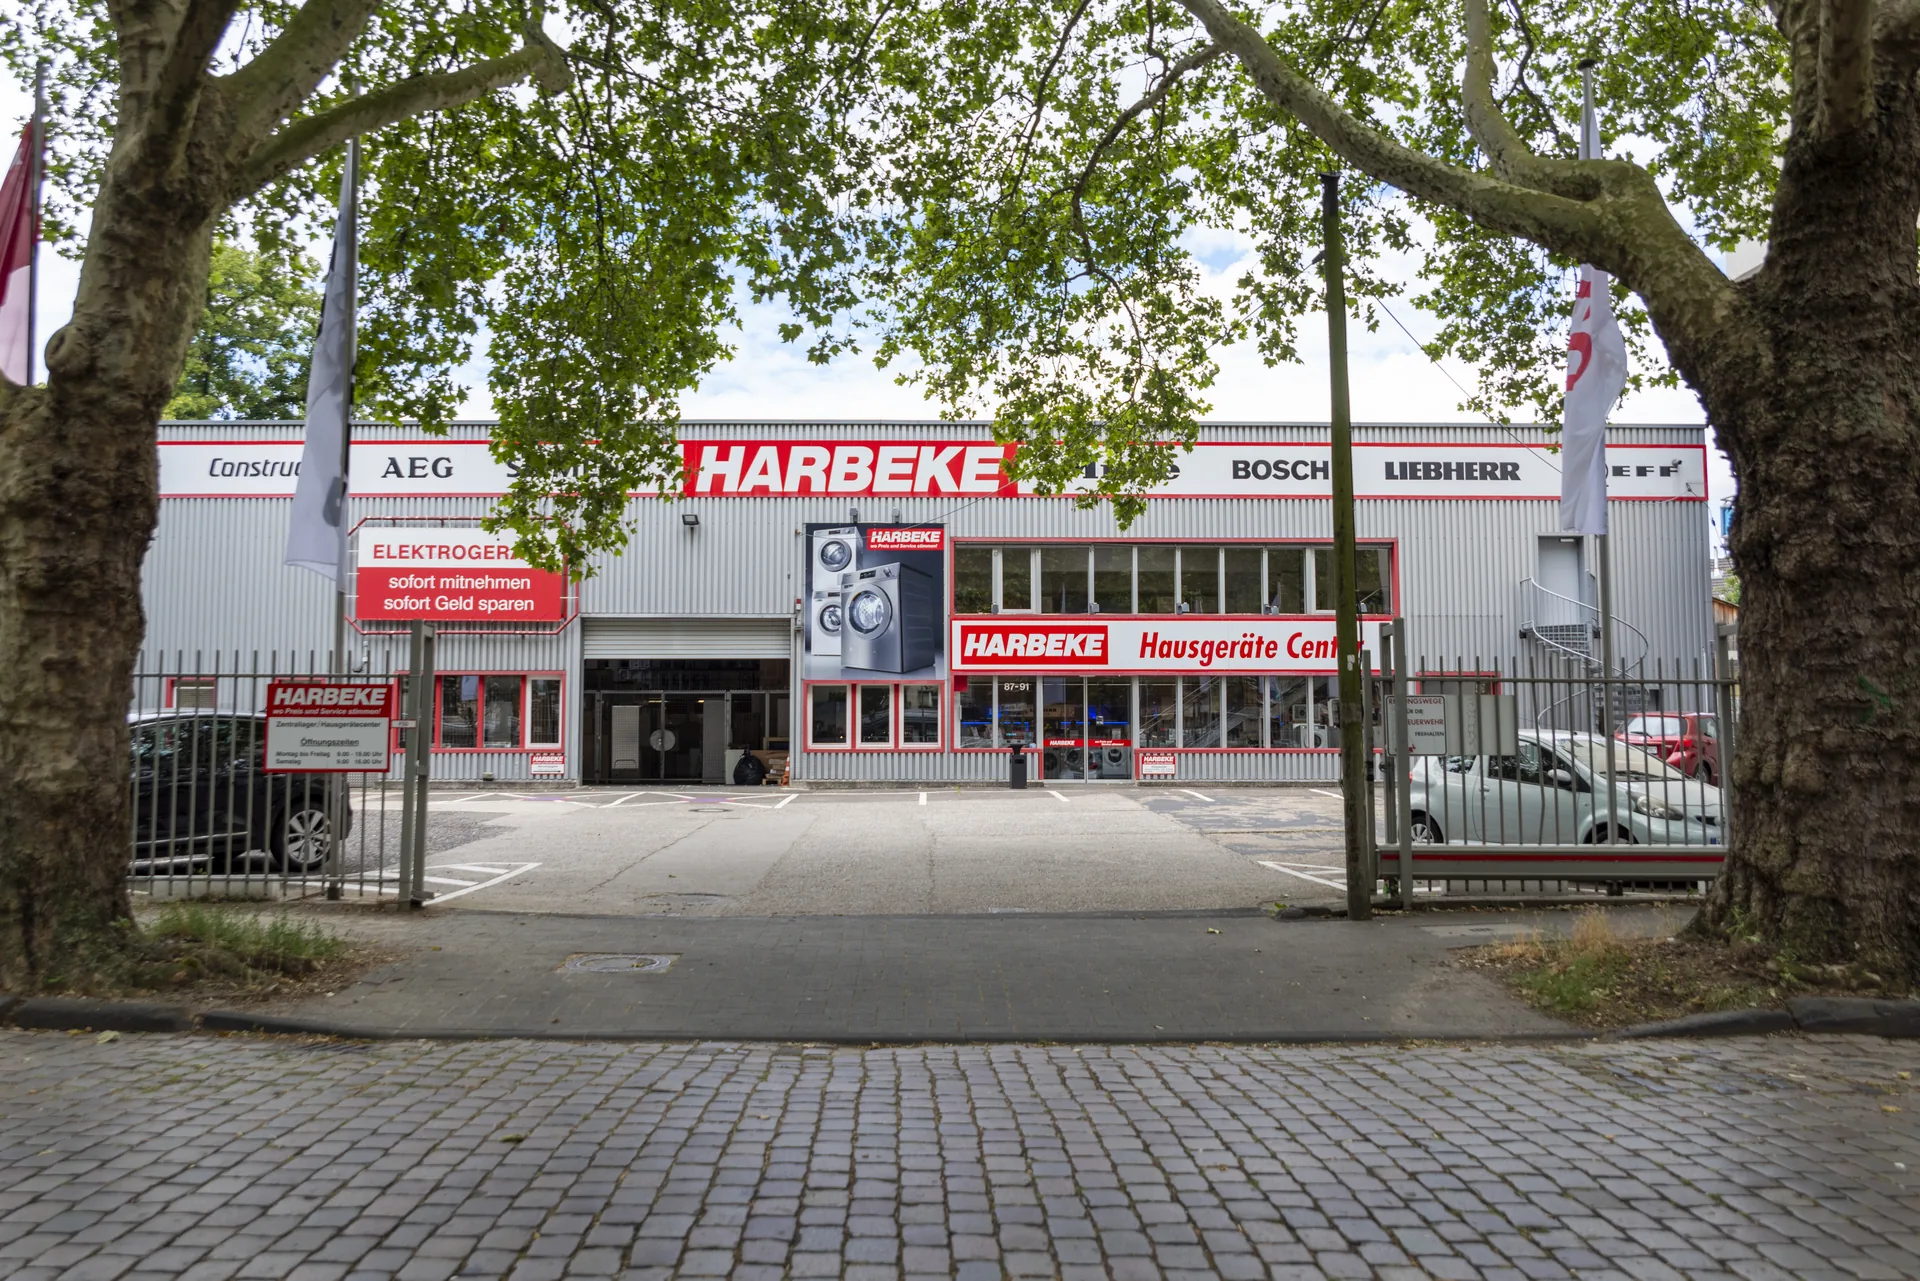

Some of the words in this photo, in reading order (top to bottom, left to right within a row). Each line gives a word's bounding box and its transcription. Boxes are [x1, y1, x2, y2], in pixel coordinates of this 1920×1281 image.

[381, 456, 454, 478] AEG
[695, 446, 1005, 492] HARBEKE
[1232, 459, 1329, 480] BOSCH
[1385, 461, 1521, 481] LIEBHERR
[1605, 465, 1679, 478] EFF
[870, 531, 941, 543] HARBEKE
[388, 574, 436, 590] sofort
[439, 574, 531, 590] mitnehmen
[384, 595, 431, 610] sofort
[434, 595, 474, 610] Geld
[477, 598, 535, 614] sparen
[963, 633, 1106, 657] HARBEKE
[1139, 631, 1277, 667] Hausgeräte
[1286, 631, 1364, 659] Cent
[1003, 682, 1030, 691] 87-91
[273, 687, 388, 706] HARBEKE
[1407, 718, 1444, 726] EUERWEHR
[300, 737, 360, 747] Öffnungszeiten
[275, 758, 302, 766] Samstag
